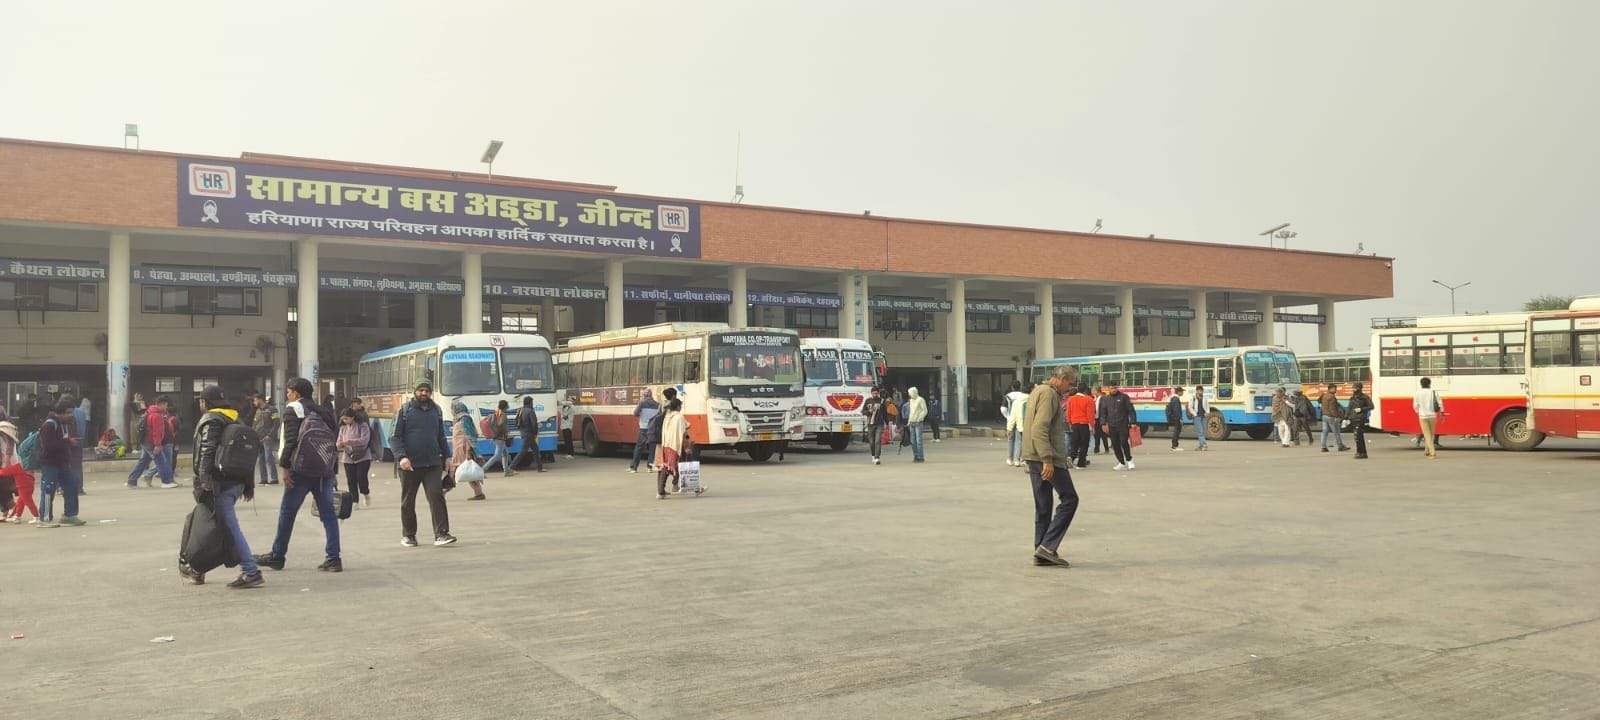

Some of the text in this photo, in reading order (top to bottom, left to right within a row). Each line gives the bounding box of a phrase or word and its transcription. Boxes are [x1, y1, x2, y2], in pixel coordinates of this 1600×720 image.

[202, 173, 223, 190] HR
[245, 174, 392, 209] सामान्य
[398, 187, 458, 214] बस
[577, 199, 654, 230] जीन्द
[667, 212, 681, 226] HR
[247, 210, 322, 227] हरियाणा
[326, 217, 369, 230] राज्य
[372, 218, 438, 235] परिवहन
[441, 225, 494, 238] आपका
[497, 227, 545, 242] हार्दिक
[550, 233, 595, 246] स्वागत
[597, 236, 635, 249] करता
[9, 261, 105, 278] कैथल लोकल
[262, 272, 297, 287] पंचकूला
[483, 284, 607, 299] 10. नरवाना लोकल
[624, 290, 639, 299] 11.
[673, 290, 703, 301] पानीपत
[704, 291, 731, 302] लोकल
[722, 335, 747, 344] HARYANA
[445, 352, 494, 360] HARYANA ROADWAYS
[803, 349, 872, 360] SAASAR EXPRESS
